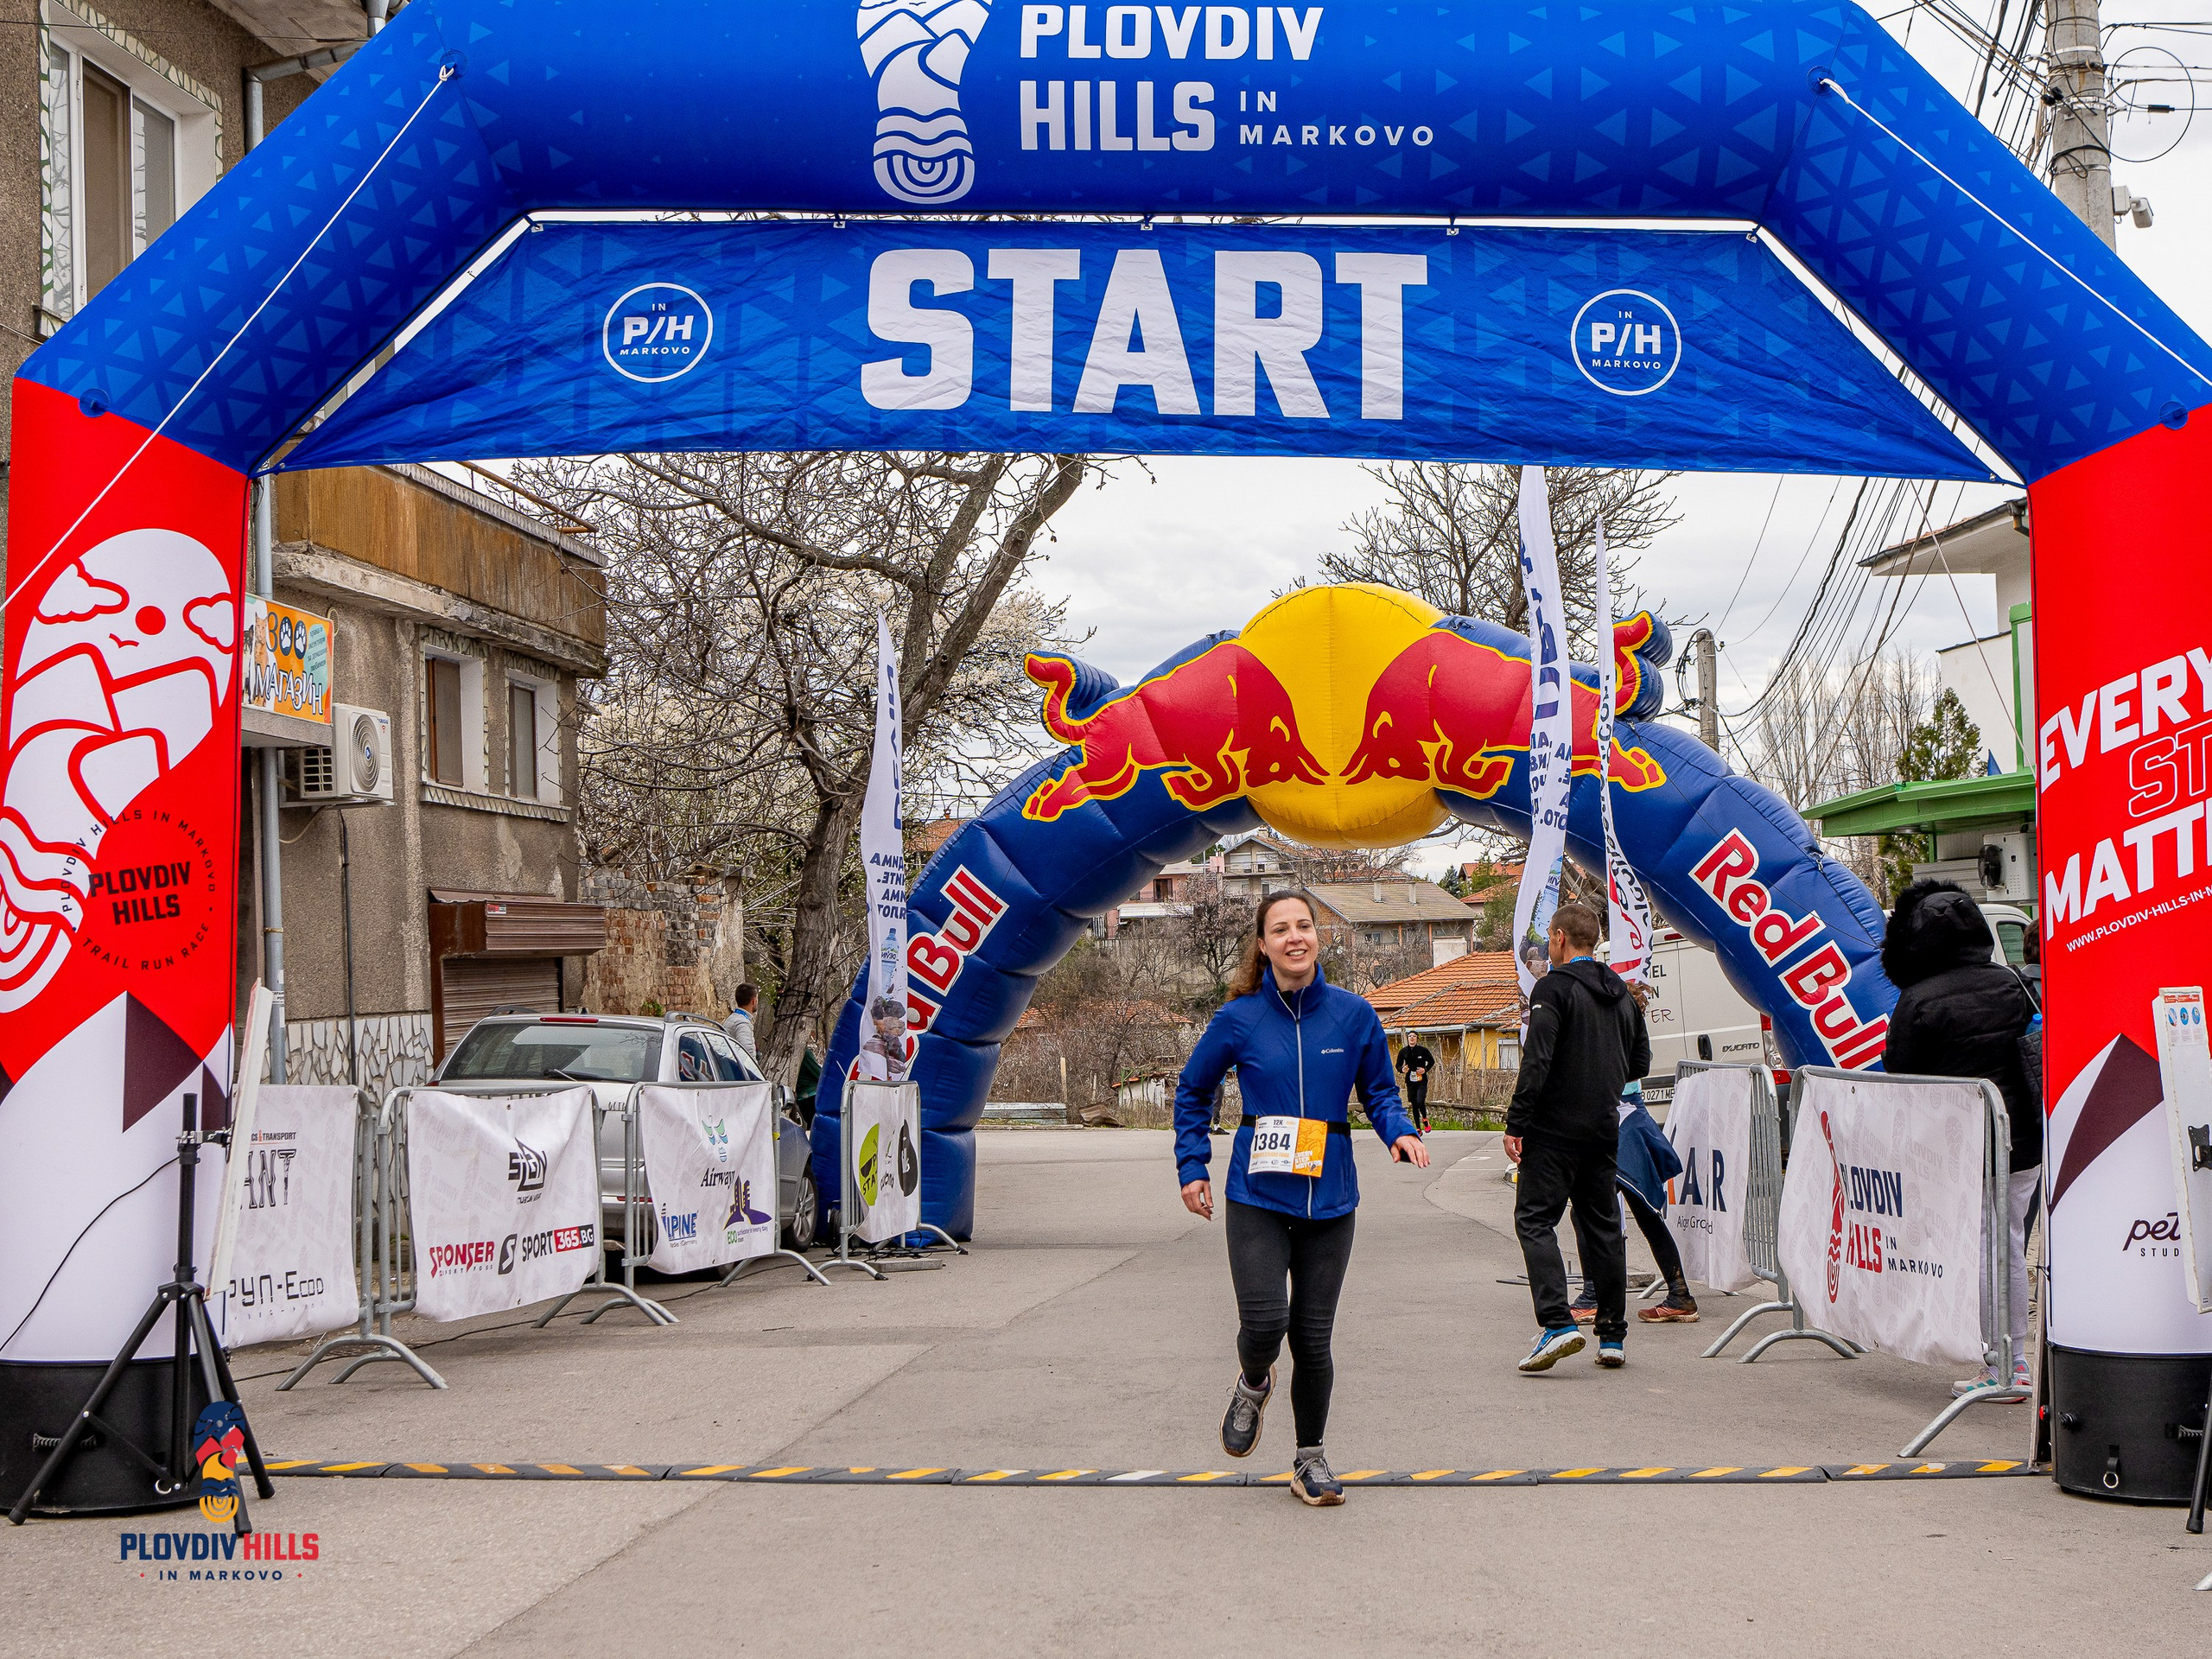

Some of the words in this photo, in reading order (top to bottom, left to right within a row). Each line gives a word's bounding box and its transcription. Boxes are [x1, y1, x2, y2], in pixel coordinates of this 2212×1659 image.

[1020, 4, 1325, 60] PLOVDIV
[1020, 80, 1216, 151] HILLS
[1240, 91, 1276, 112] IN
[1240, 124, 1433, 146] MARKOVO
[652, 302, 666, 311] IN
[623, 315, 694, 346] P/H
[861, 249, 1427, 420] START
[1592, 322, 1662, 357] P/H
[620, 346, 690, 356] MARKOVO
[1592, 359, 1661, 370] MARKOVO
[255, 663, 324, 715] МАГАЗИН
[91, 810, 142, 836] HILLS
[154, 810, 170, 823] IN
[178, 819, 215, 892] MARKOVO
[88, 861, 191, 898] PLOVDIV
[112, 893, 181, 925] HILLS
[83, 938, 129, 969] TRAIL
[141, 957, 175, 970] RUN
[181, 923, 209, 958] RACE
[1691, 830, 1824, 965] Red
[1780, 942, 1889, 1071] Bull
[1722, 1042, 1760, 1052] DUCATO
[1647, 1089, 1664, 1100] 0271
[262, 1132, 297, 1141] TRANSPORT
[1254, 1133, 1291, 1152] 1384
[1885, 1236, 1897, 1250] IN
[429, 1241, 495, 1279] SPONSER
[1887, 1257, 1943, 1279] MARKOVO
